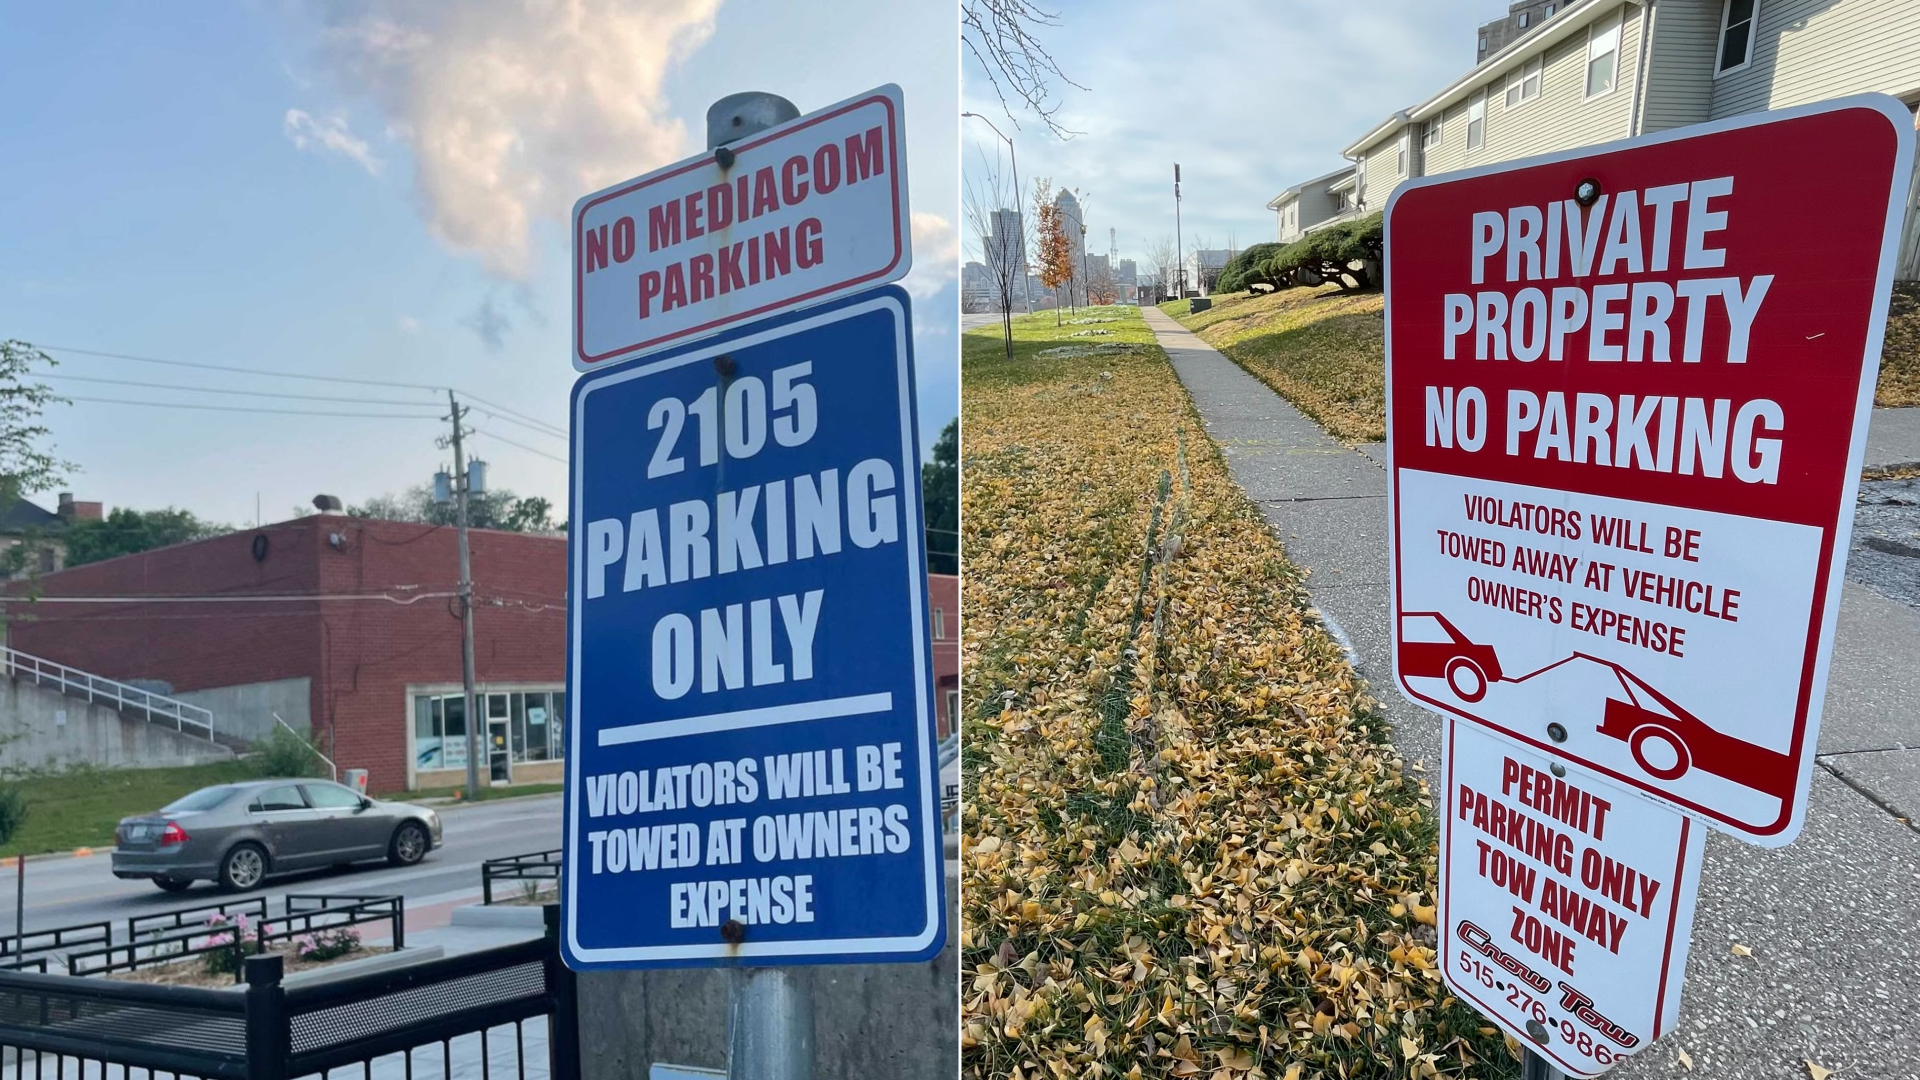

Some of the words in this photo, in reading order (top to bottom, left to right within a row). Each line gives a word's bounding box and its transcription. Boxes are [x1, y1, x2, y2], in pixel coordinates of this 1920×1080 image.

[586, 216, 635, 273] NO
[649, 126, 884, 253] MEDIACOM
[1471, 176, 1734, 284] PRIVATE
[638, 217, 824, 320] PARKING
[1443, 274, 1775, 364] PROPERTY
[647, 360, 818, 480] 2105
[1425, 386, 1487, 453] NO
[1506, 389, 1785, 485] PARKING
[587, 458, 898, 600] PARKING
[1464, 494, 1582, 541] VIOLATORS
[1590, 514, 1654, 555] WILL
[1664, 527, 1701, 563] BE
[1437, 529, 1506, 568] TOWED
[1512, 546, 1578, 584] AWAY
[1584, 561, 1615, 593] AT
[1622, 567, 1741, 623] VEHICLE
[1467, 576, 1563, 624] OWNER'S
[1571, 603, 1686, 658] EXPENSE
[652, 588, 824, 700] ONLY
[586, 757, 758, 818] VIOLATORS
[764, 748, 850, 800] WILL
[856, 742, 904, 792] BE
[1502, 756, 1612, 842] PERMIT
[588, 822, 700, 874] TOWED
[706, 818, 746, 866] AT
[753, 804, 911, 863] OWNERS
[1459, 784, 1574, 878] PARKING
[1581, 847, 1661, 919] ONLY
[670, 875, 815, 929] EXPENSE
[1476, 839, 1537, 904] TOW
[1540, 876, 1629, 955] AWAY
[1510, 905, 1576, 977] ZONE
[1558, 980, 1640, 1048] Tow
